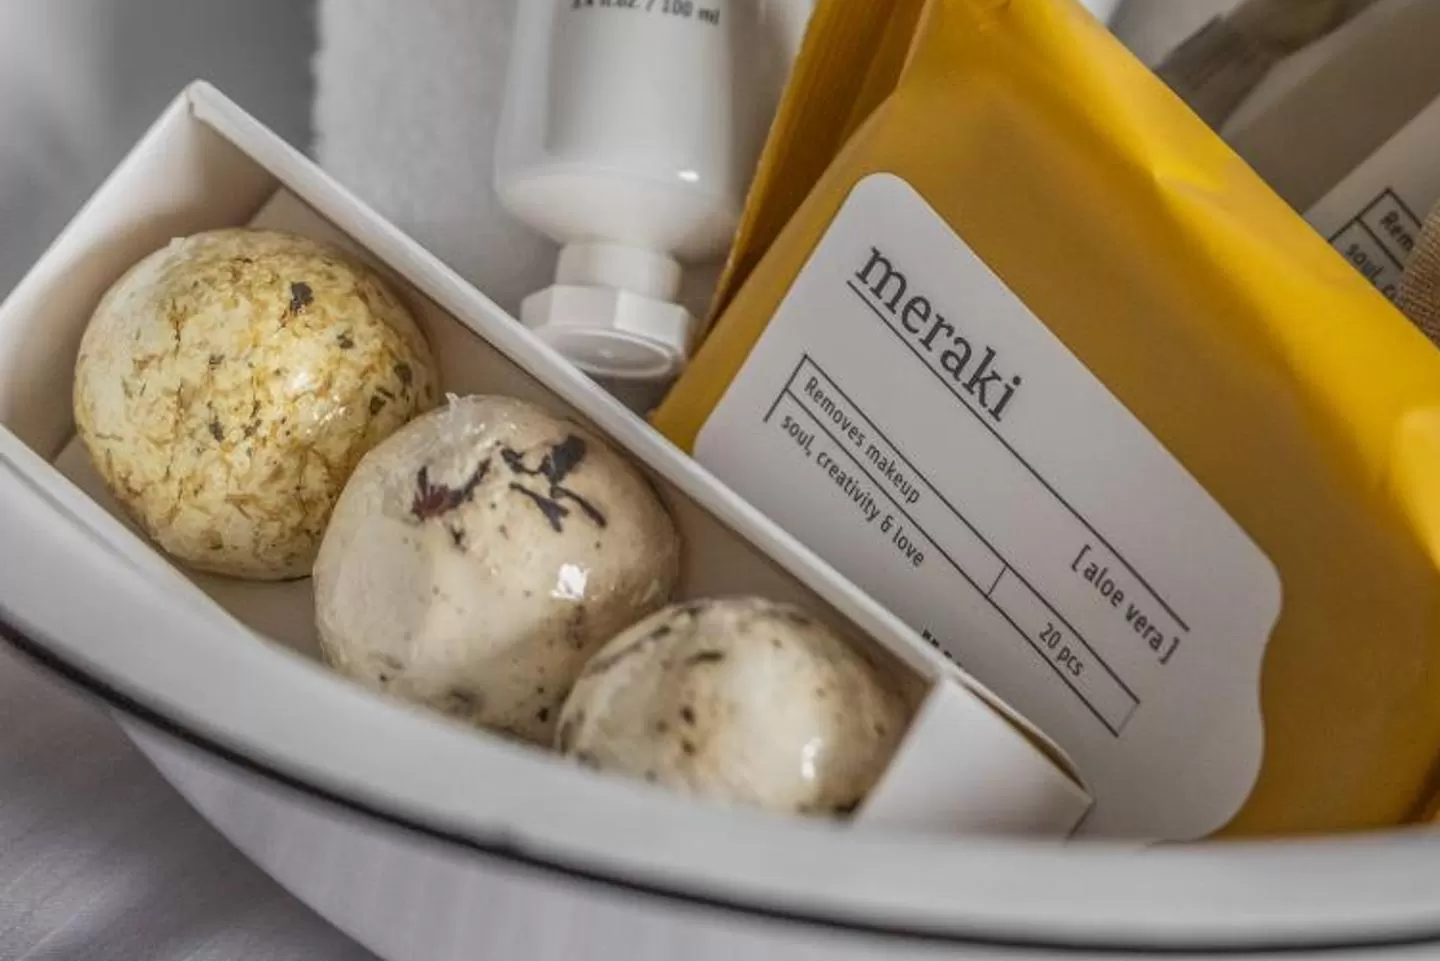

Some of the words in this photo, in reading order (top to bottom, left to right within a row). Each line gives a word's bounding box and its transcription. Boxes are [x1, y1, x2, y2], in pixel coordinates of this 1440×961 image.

[855, 245, 1022, 423] meraki
[780, 414, 816, 457] soul,
[816, 450, 881, 523] creativity
[880, 514, 894, 534] &
[892, 525, 925, 568] love
[804, 375, 866, 448] Removes
[864, 443, 921, 505] makeup
[1038, 621, 1062, 650] 20
[1056, 645, 1084, 677] pcs
